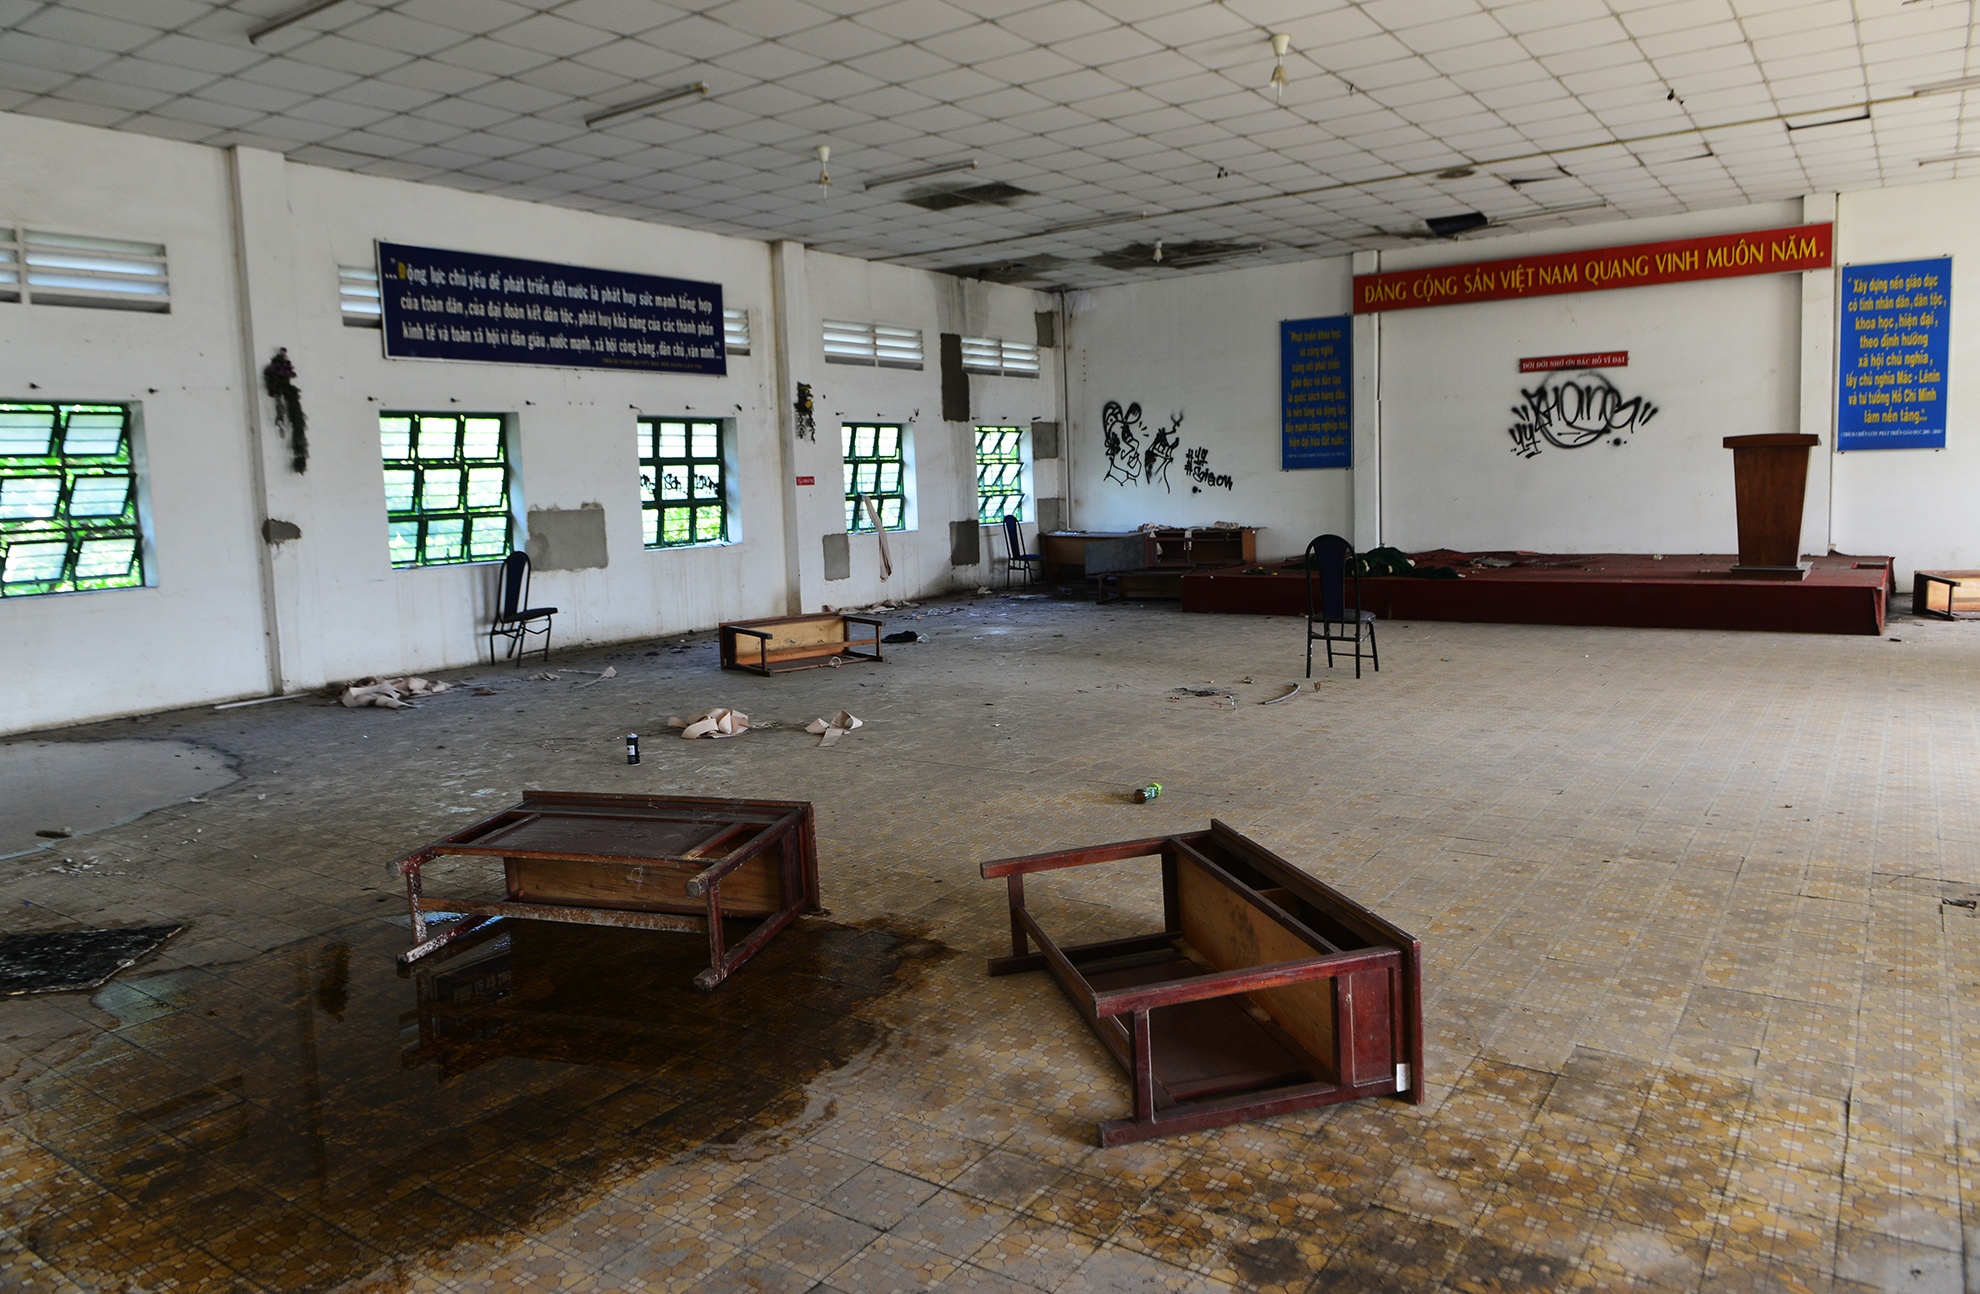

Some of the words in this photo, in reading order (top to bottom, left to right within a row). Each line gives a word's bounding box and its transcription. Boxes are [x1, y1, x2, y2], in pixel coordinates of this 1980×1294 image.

[1365, 278, 1407, 304] ĐẢNG
[1413, 274, 1458, 302] CỘNG
[1464, 267, 1495, 294] SẢN
[1500, 264, 1535, 293] VIỆT
[1539, 263, 1578, 287] NAM
[1585, 255, 1650, 286] QUANG
[1655, 249, 1699, 274] VINH
[1706, 238, 1764, 269] MUÔN
